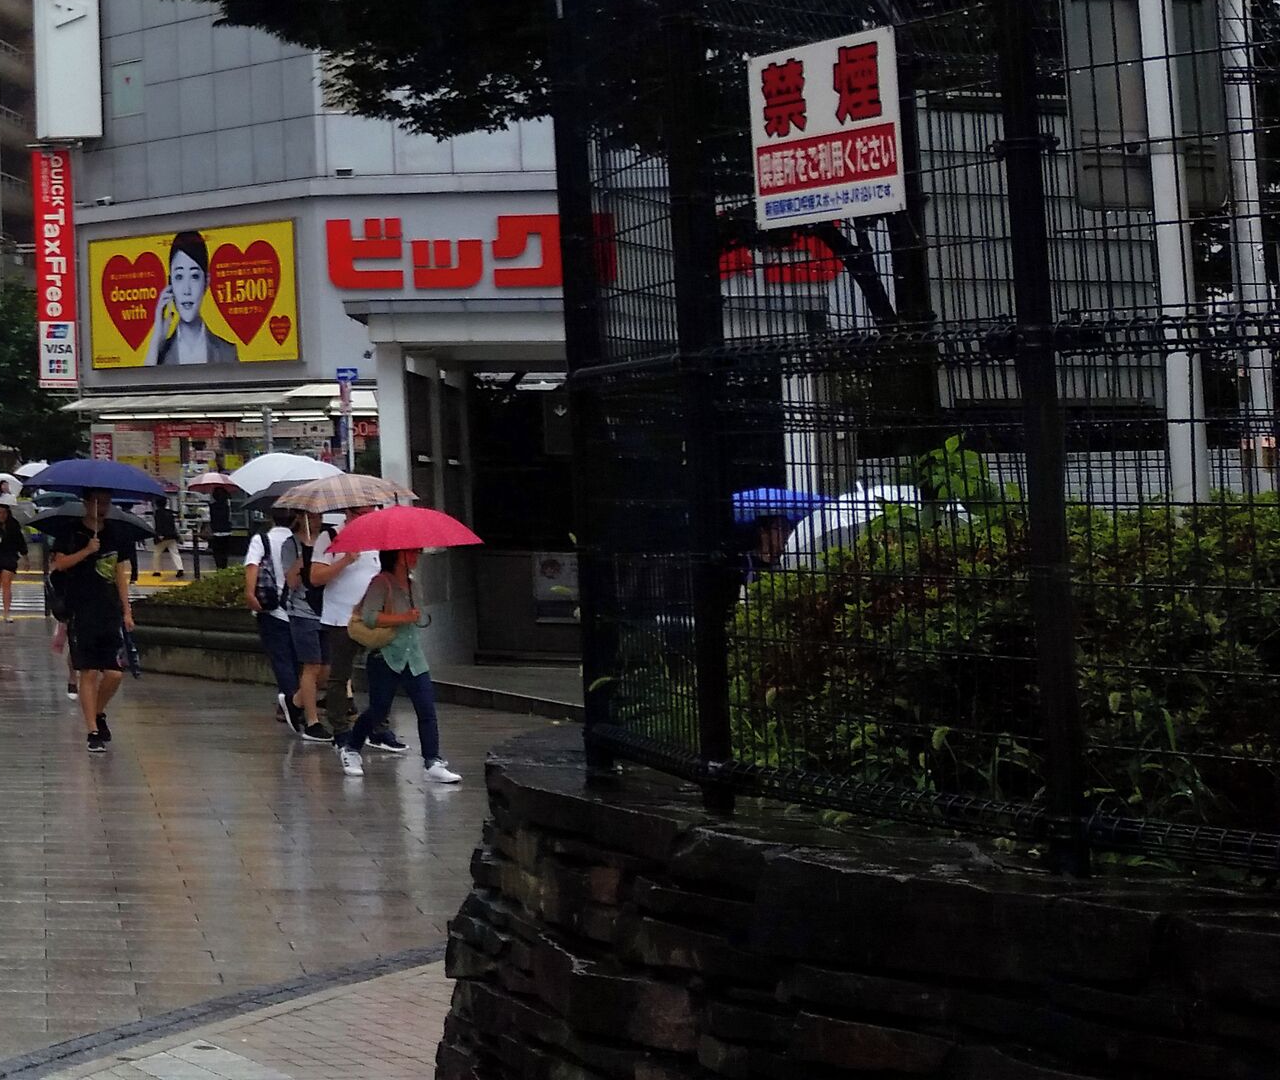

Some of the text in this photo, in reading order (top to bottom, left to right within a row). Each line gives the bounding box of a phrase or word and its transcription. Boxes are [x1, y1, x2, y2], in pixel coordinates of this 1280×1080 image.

[761, 41, 883, 138] 禁煙
[758, 135, 896, 189] 喫煙所をご利用ください
[43, 208, 68, 318] TaxFree
[110, 285, 158, 302] docomo
[121, 305, 148, 321] with
[44, 343, 73, 355] VISA
